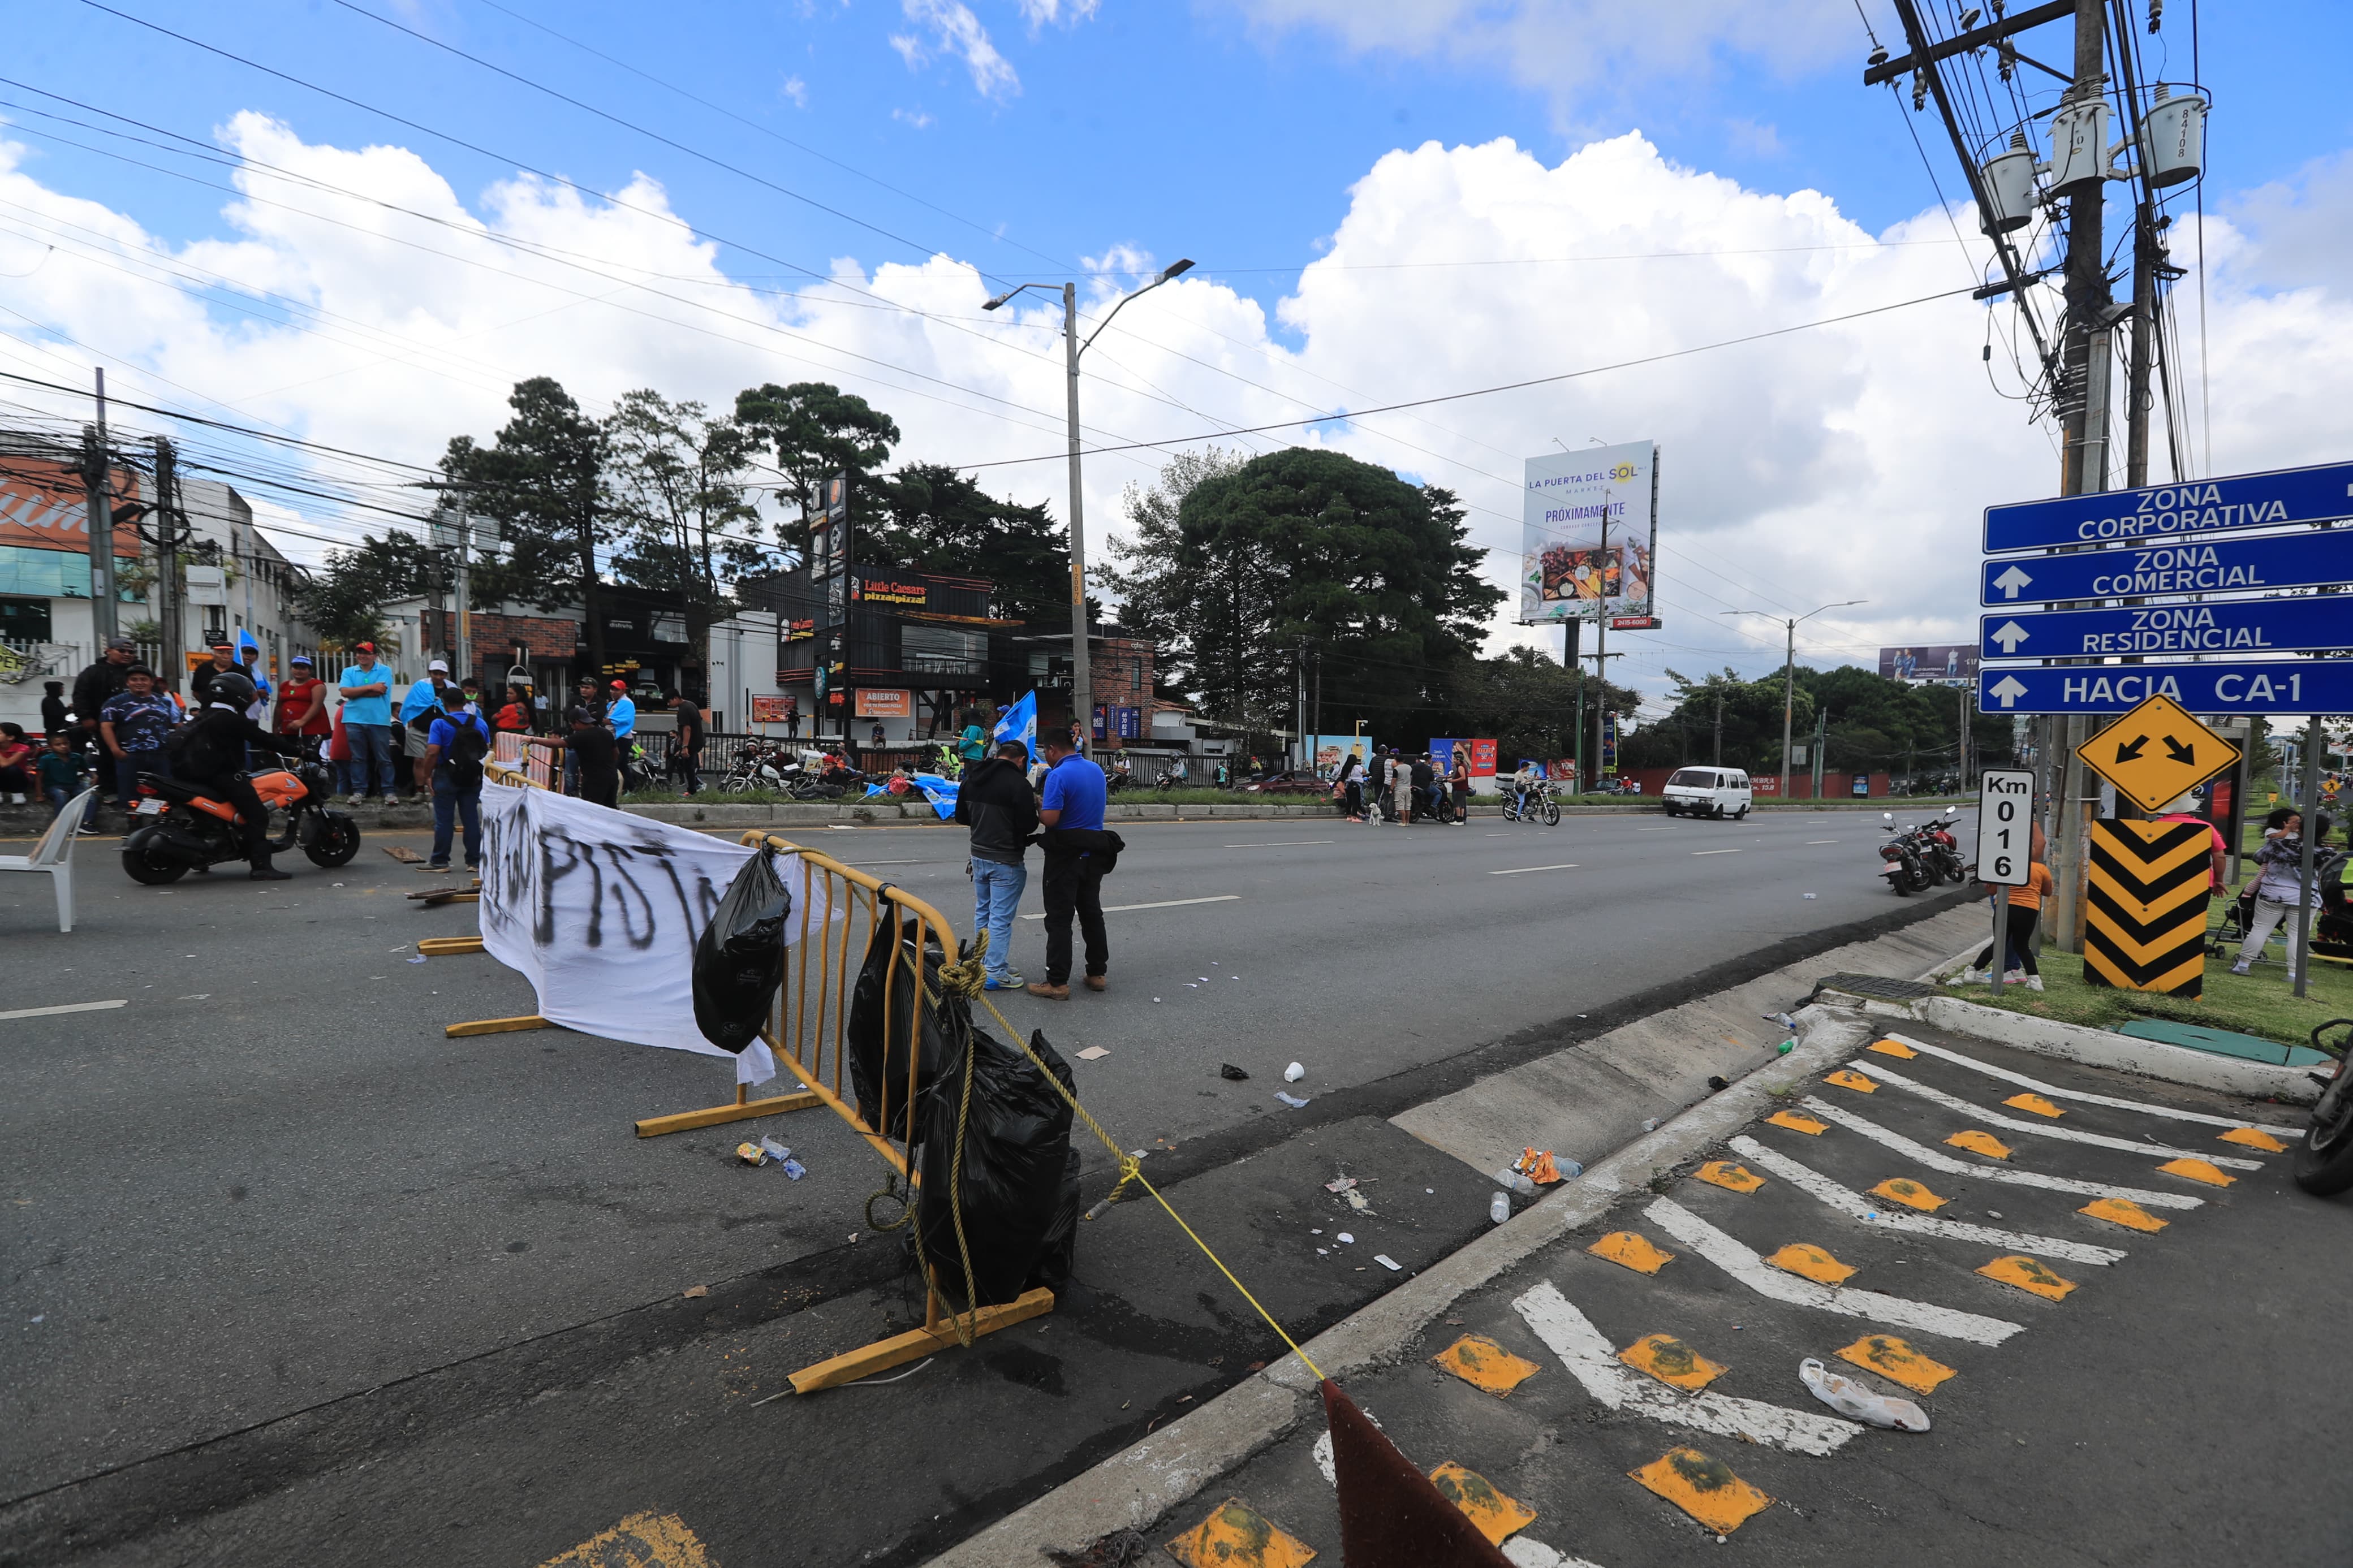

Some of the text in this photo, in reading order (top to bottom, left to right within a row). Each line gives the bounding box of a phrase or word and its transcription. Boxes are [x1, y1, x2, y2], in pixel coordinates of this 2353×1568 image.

[1529, 466, 1639, 489] LA PUERTA DEL SOL
[1566, 485, 1604, 495] MARKET
[2136, 484, 2222, 513] ZONA
[1545, 502, 1626, 522] PRÓXIMAMENTE
[2078, 500, 2288, 539] CORPORATIVA
[2134, 546, 2219, 572] ZONA
[864, 579, 926, 595] Little Caesars
[2093, 565, 2265, 594] COMERCIAL
[2131, 608, 2216, 630] ZONA
[2083, 627, 2272, 652] RESIDENCIAL
[867, 693, 900, 701] ABIERTO
[2063, 673, 2301, 702] HACIA CA-1
[1988, 777, 2027, 794] Km
